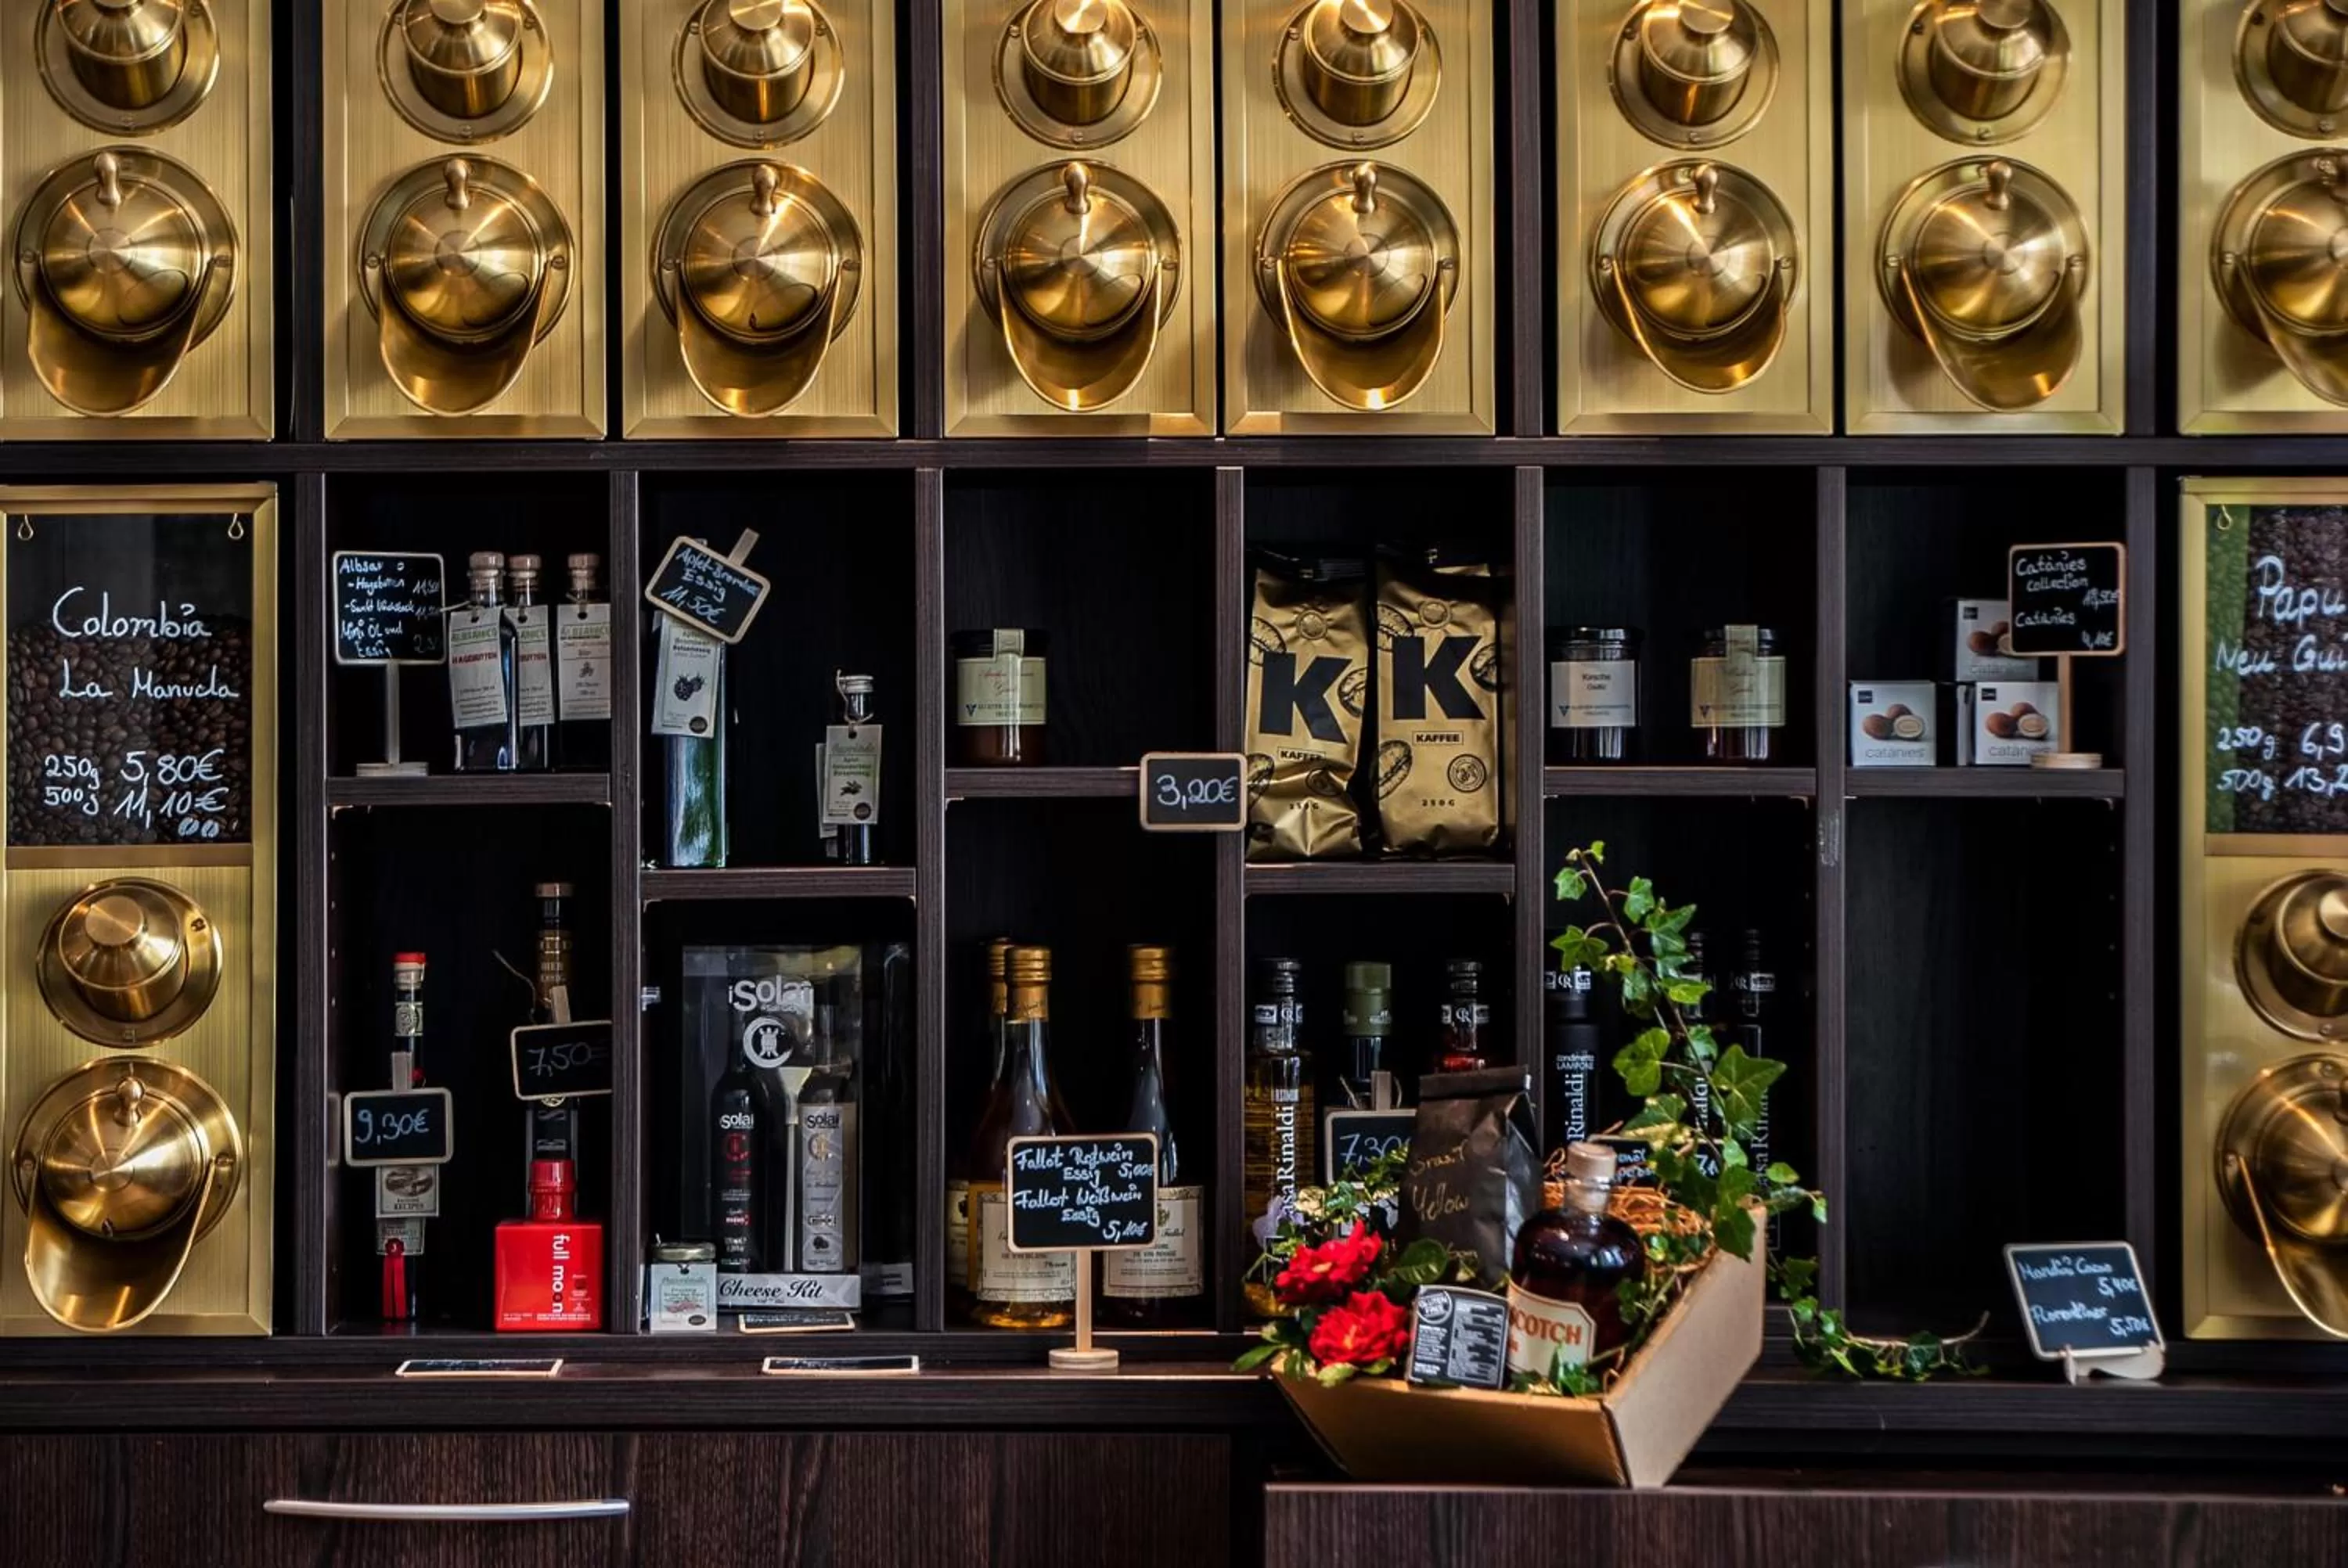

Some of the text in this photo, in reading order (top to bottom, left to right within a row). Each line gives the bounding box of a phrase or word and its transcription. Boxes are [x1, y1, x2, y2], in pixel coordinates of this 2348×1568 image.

[682, 569, 726, 602] Essig
[52, 587, 211, 638] Colombia
[2217, 638, 2276, 675] Neu
[59, 659, 113, 697] La
[1393, 635, 1486, 728] K
[1259, 650, 1352, 744] K
[1416, 733, 1460, 743] KAFFEE
[2217, 726, 2275, 761] 250g
[45, 749, 225, 789] 250g 5,80€
[2217, 768, 2275, 801] 500g
[45, 787, 229, 829] 500g 11,10€
[1565, 1073, 1584, 1141] Rinaldi
[355, 1108, 430, 1146] 9,30€
[1276, 1104, 1295, 1182] Rinaldi
[1014, 1145, 1065, 1171] Fallot
[1062, 1166, 1101, 1189] Essig
[1013, 1186, 1069, 1210] Fallot
[1061, 1206, 1101, 1228] Essig
[552, 1233, 571, 1314] full moon
[719, 1278, 783, 1299] Cheese
[786, 1278, 823, 1299] Kit
